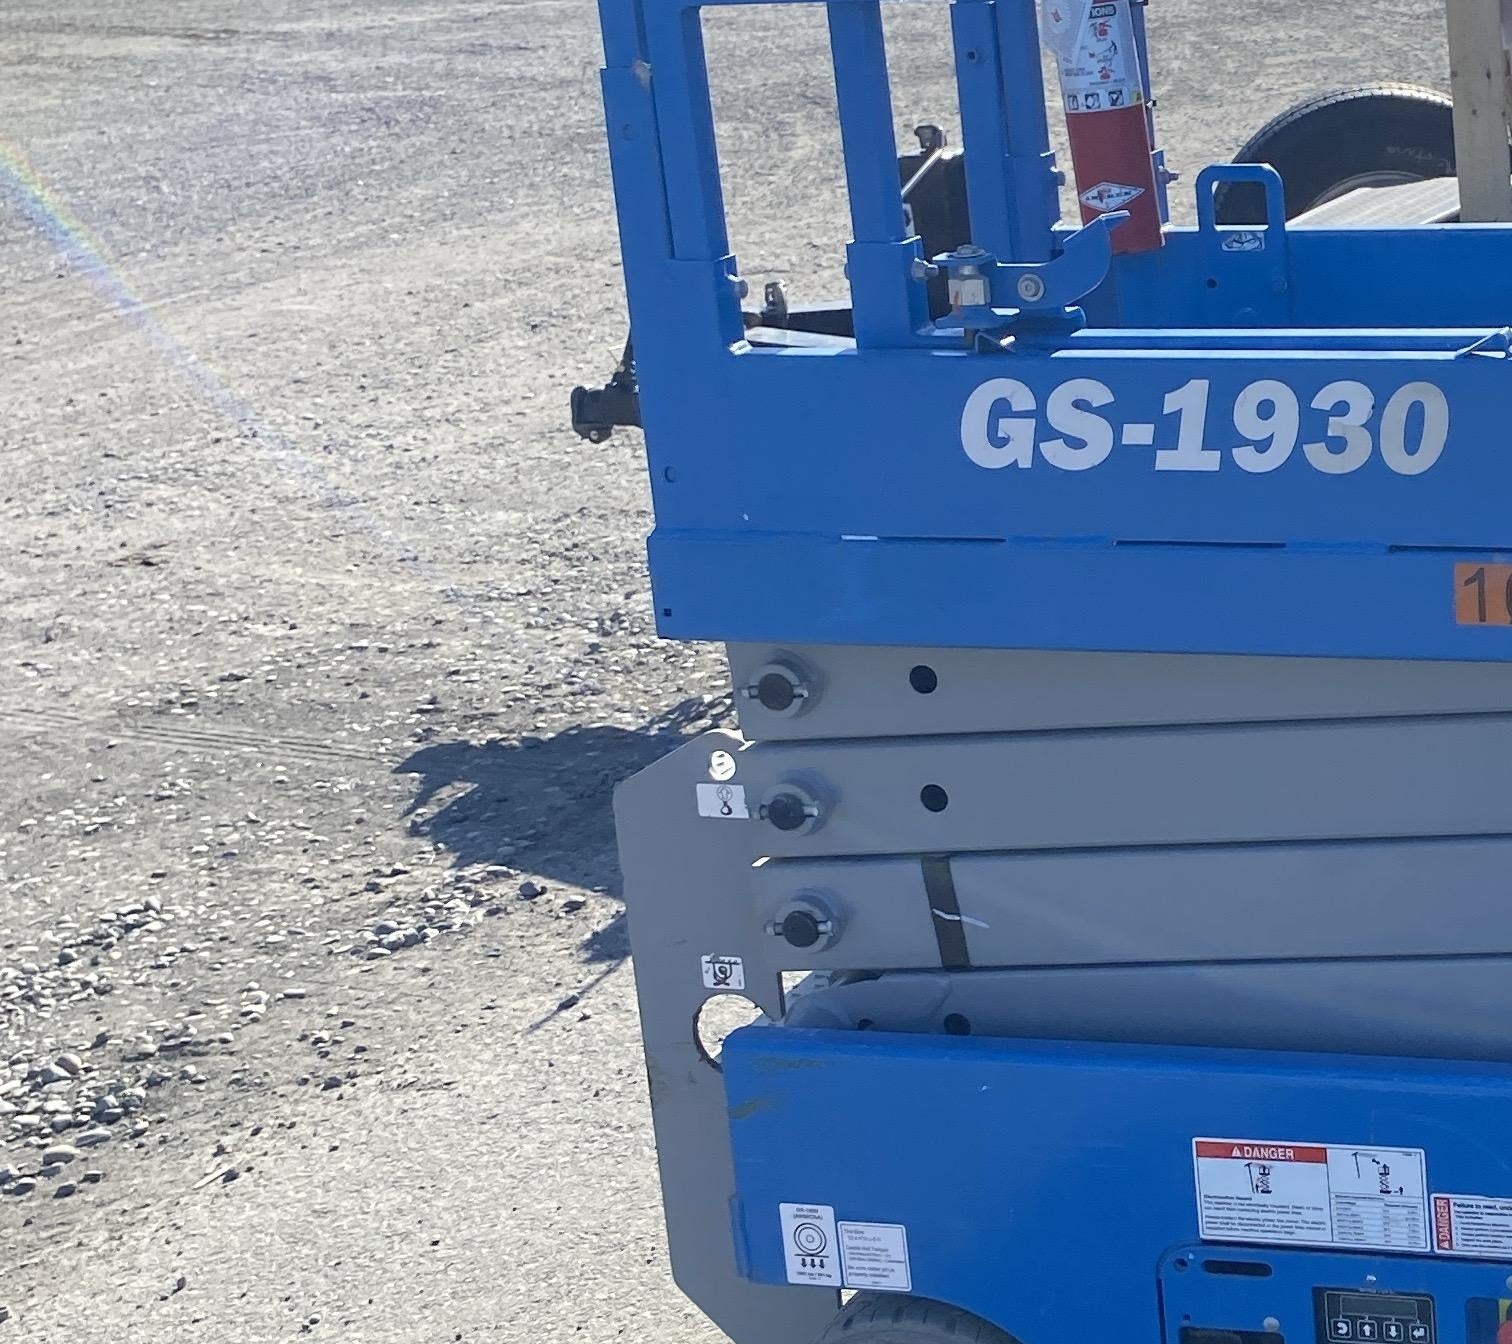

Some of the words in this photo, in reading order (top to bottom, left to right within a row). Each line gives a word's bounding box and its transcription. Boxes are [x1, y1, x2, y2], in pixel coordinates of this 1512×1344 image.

[959, 377, 1449, 476] GS-1930
[1244, 1145, 1295, 1161] DANGER
[1437, 1198, 1450, 1239] DANGER
